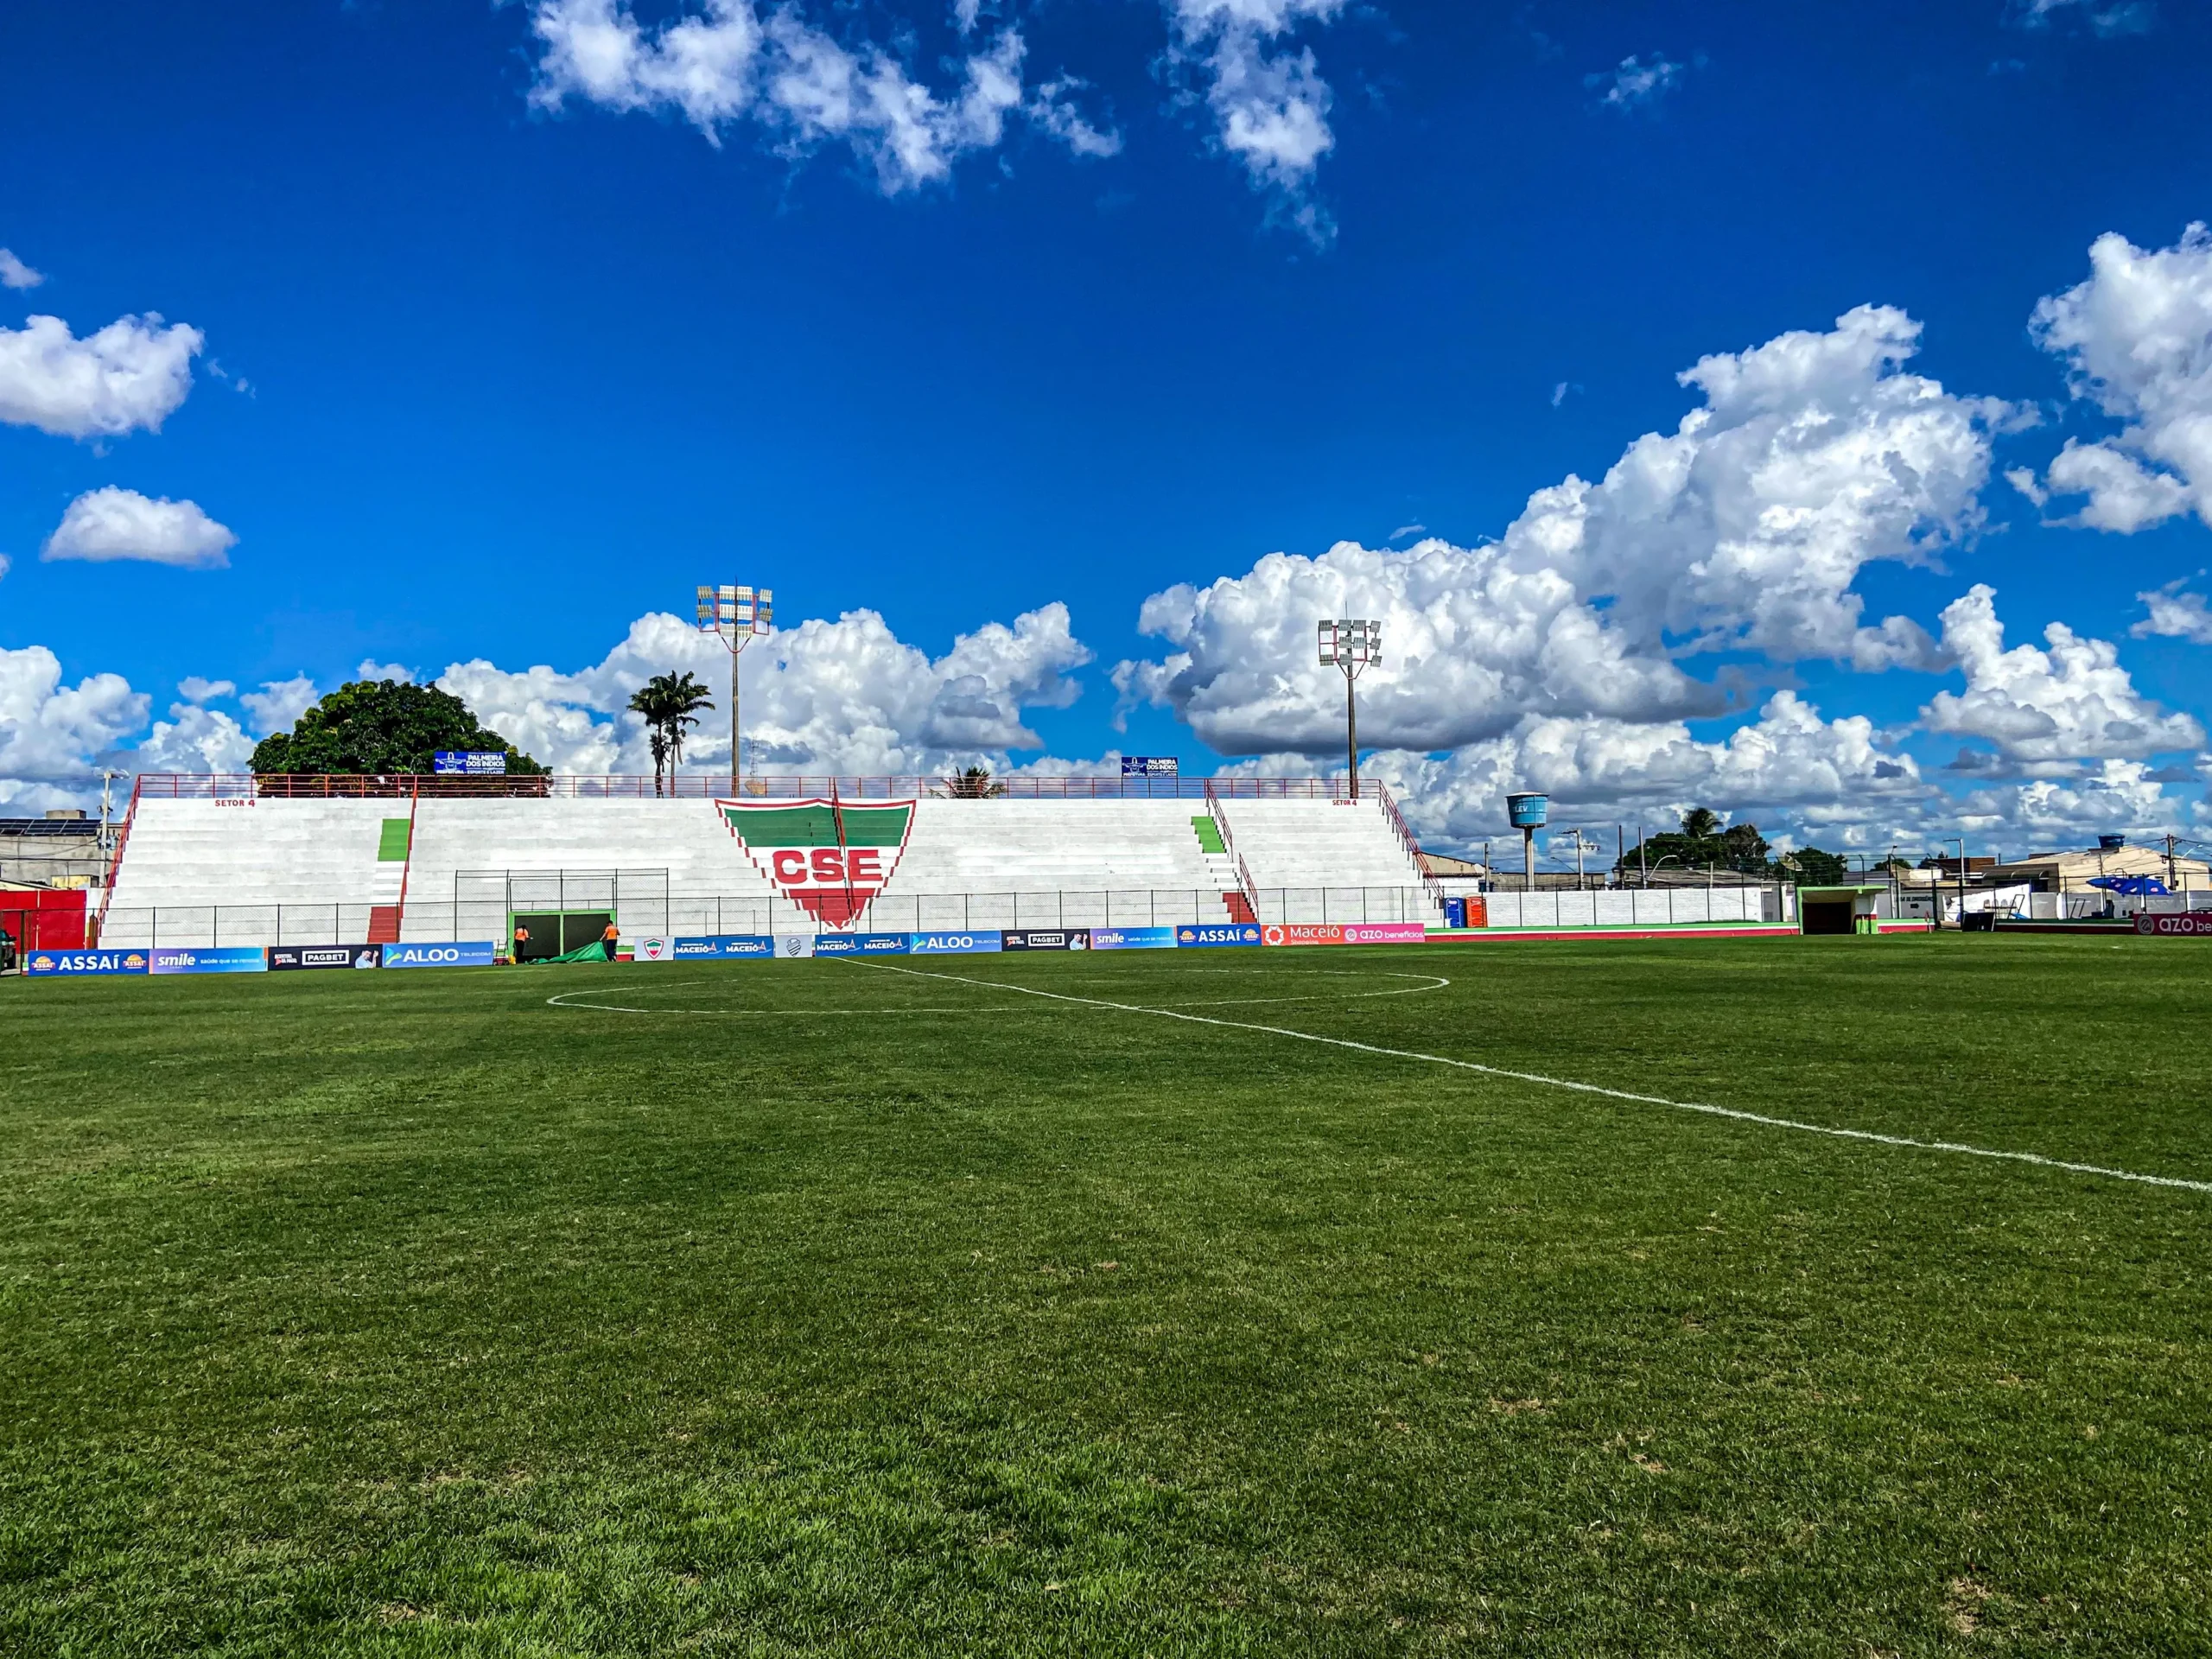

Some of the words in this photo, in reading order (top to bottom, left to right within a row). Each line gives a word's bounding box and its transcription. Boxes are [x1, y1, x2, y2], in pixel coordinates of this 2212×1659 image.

[772, 849, 883, 884] CSE
[1290, 925, 1340, 938] Maceió
[2159, 918, 2194, 932] azo
[1096, 932, 1124, 944] smile
[1198, 928, 1241, 943] ASSAÍ
[1359, 930, 1382, 939] azo
[676, 944, 709, 954] MACEIÓ
[726, 944, 758, 953] MACEIÓ
[864, 941, 895, 950] MACEIÓ
[926, 936, 973, 949] ALOO
[58, 954, 120, 970] ASSAÍ
[157, 953, 196, 967] smile
[308, 953, 344, 962] PAGBET
[403, 948, 459, 963] ALOO
